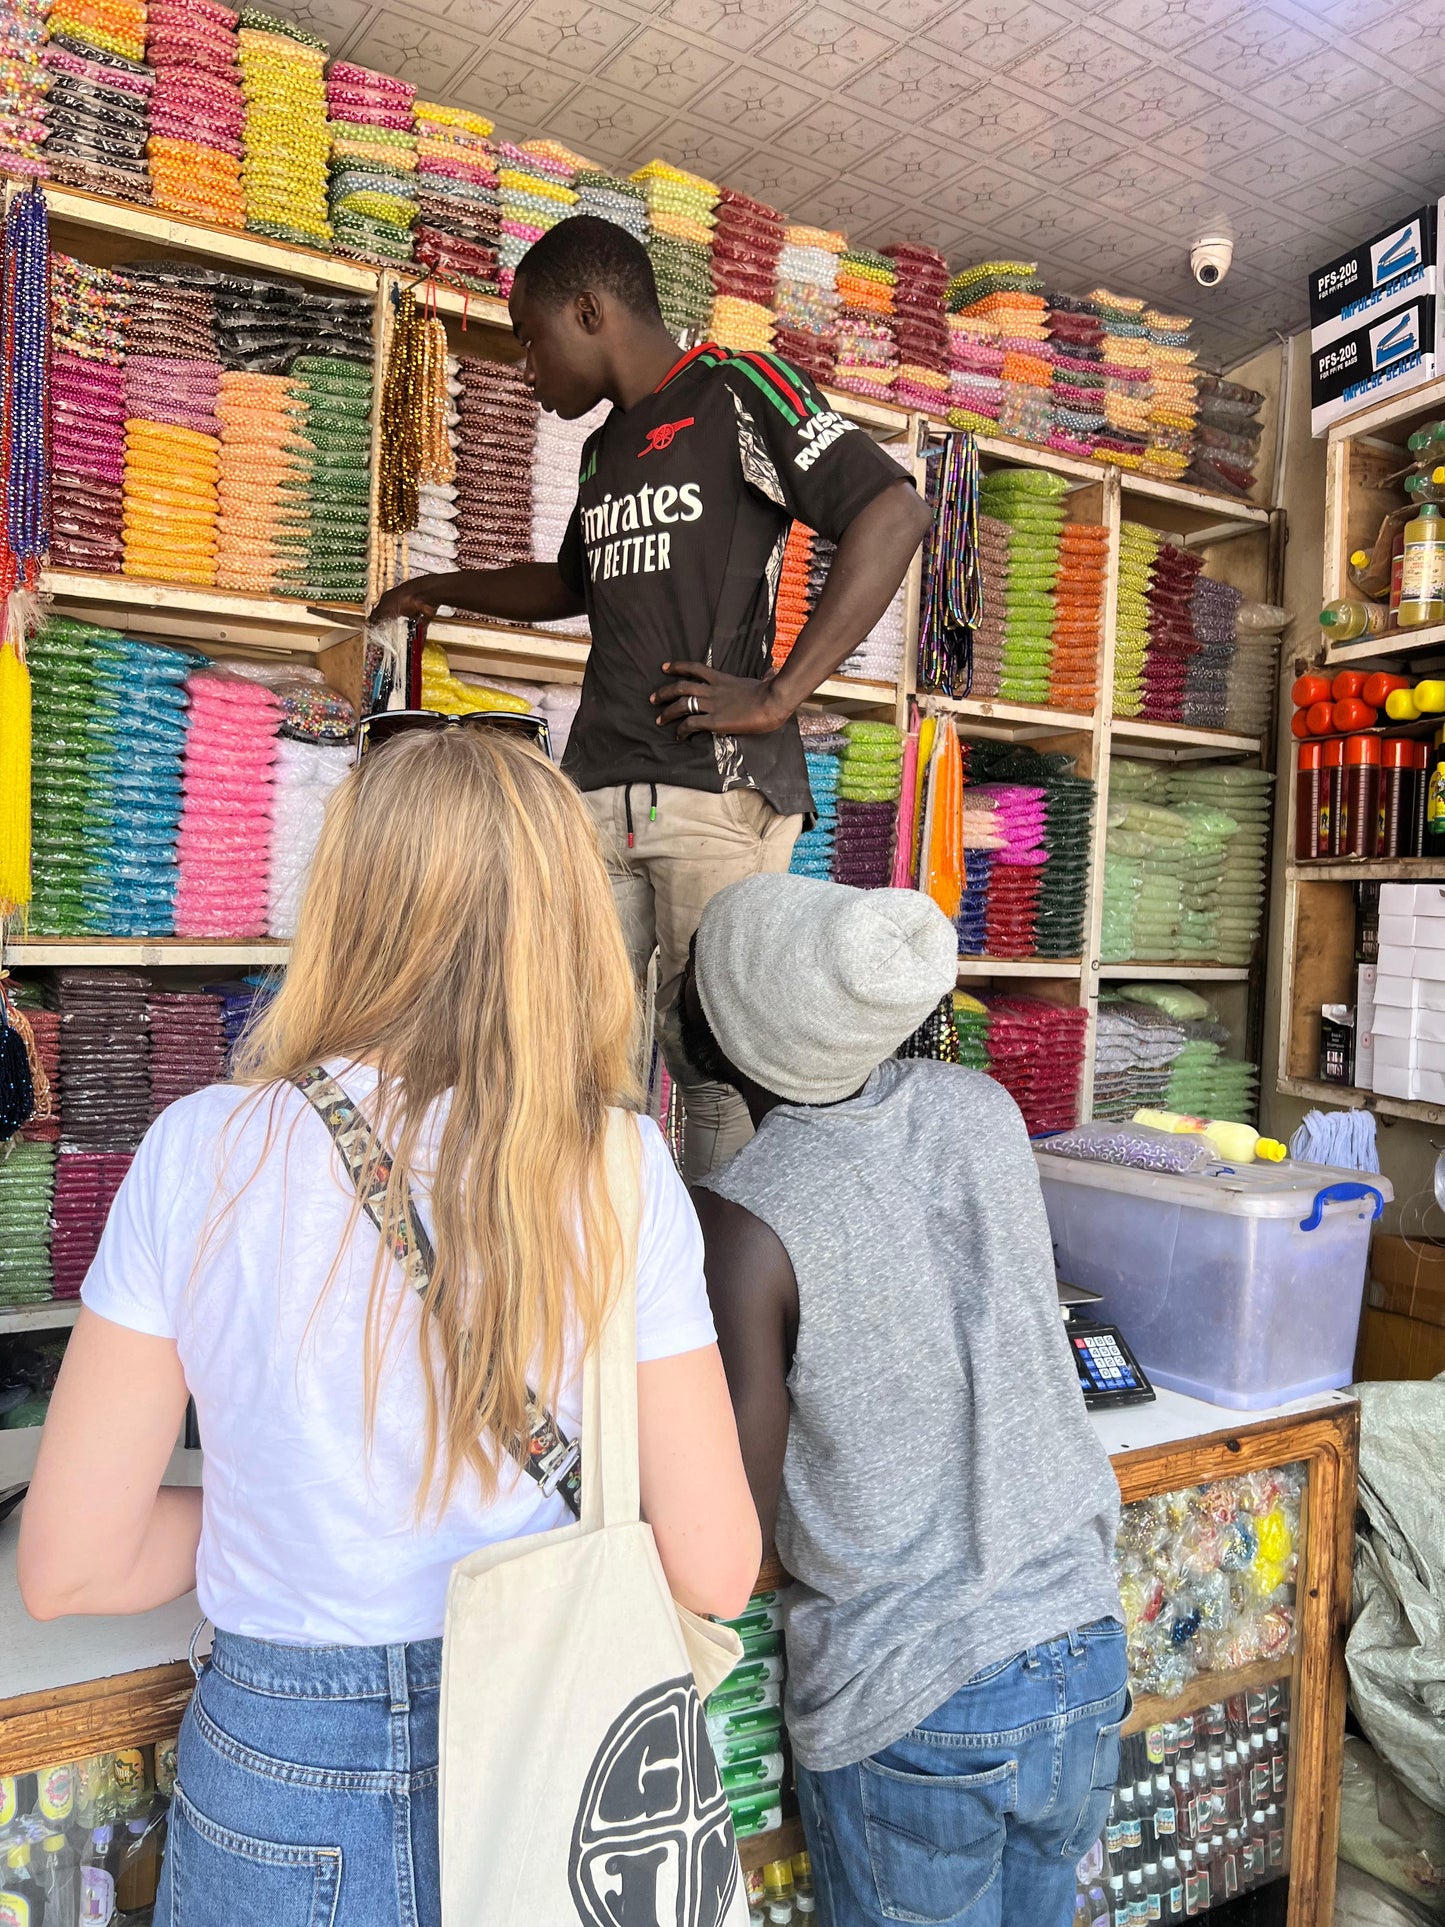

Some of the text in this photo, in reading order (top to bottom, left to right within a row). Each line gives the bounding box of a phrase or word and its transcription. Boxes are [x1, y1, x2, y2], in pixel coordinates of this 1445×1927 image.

[1318, 259, 1359, 293] PFS-200
[1341, 263, 1425, 321] IMPULSE SEALER
[1319, 342, 1357, 373] PFS-200
[1342, 350, 1422, 403] IMPULSE SEALER
[603, 531, 671, 581] BETTER
